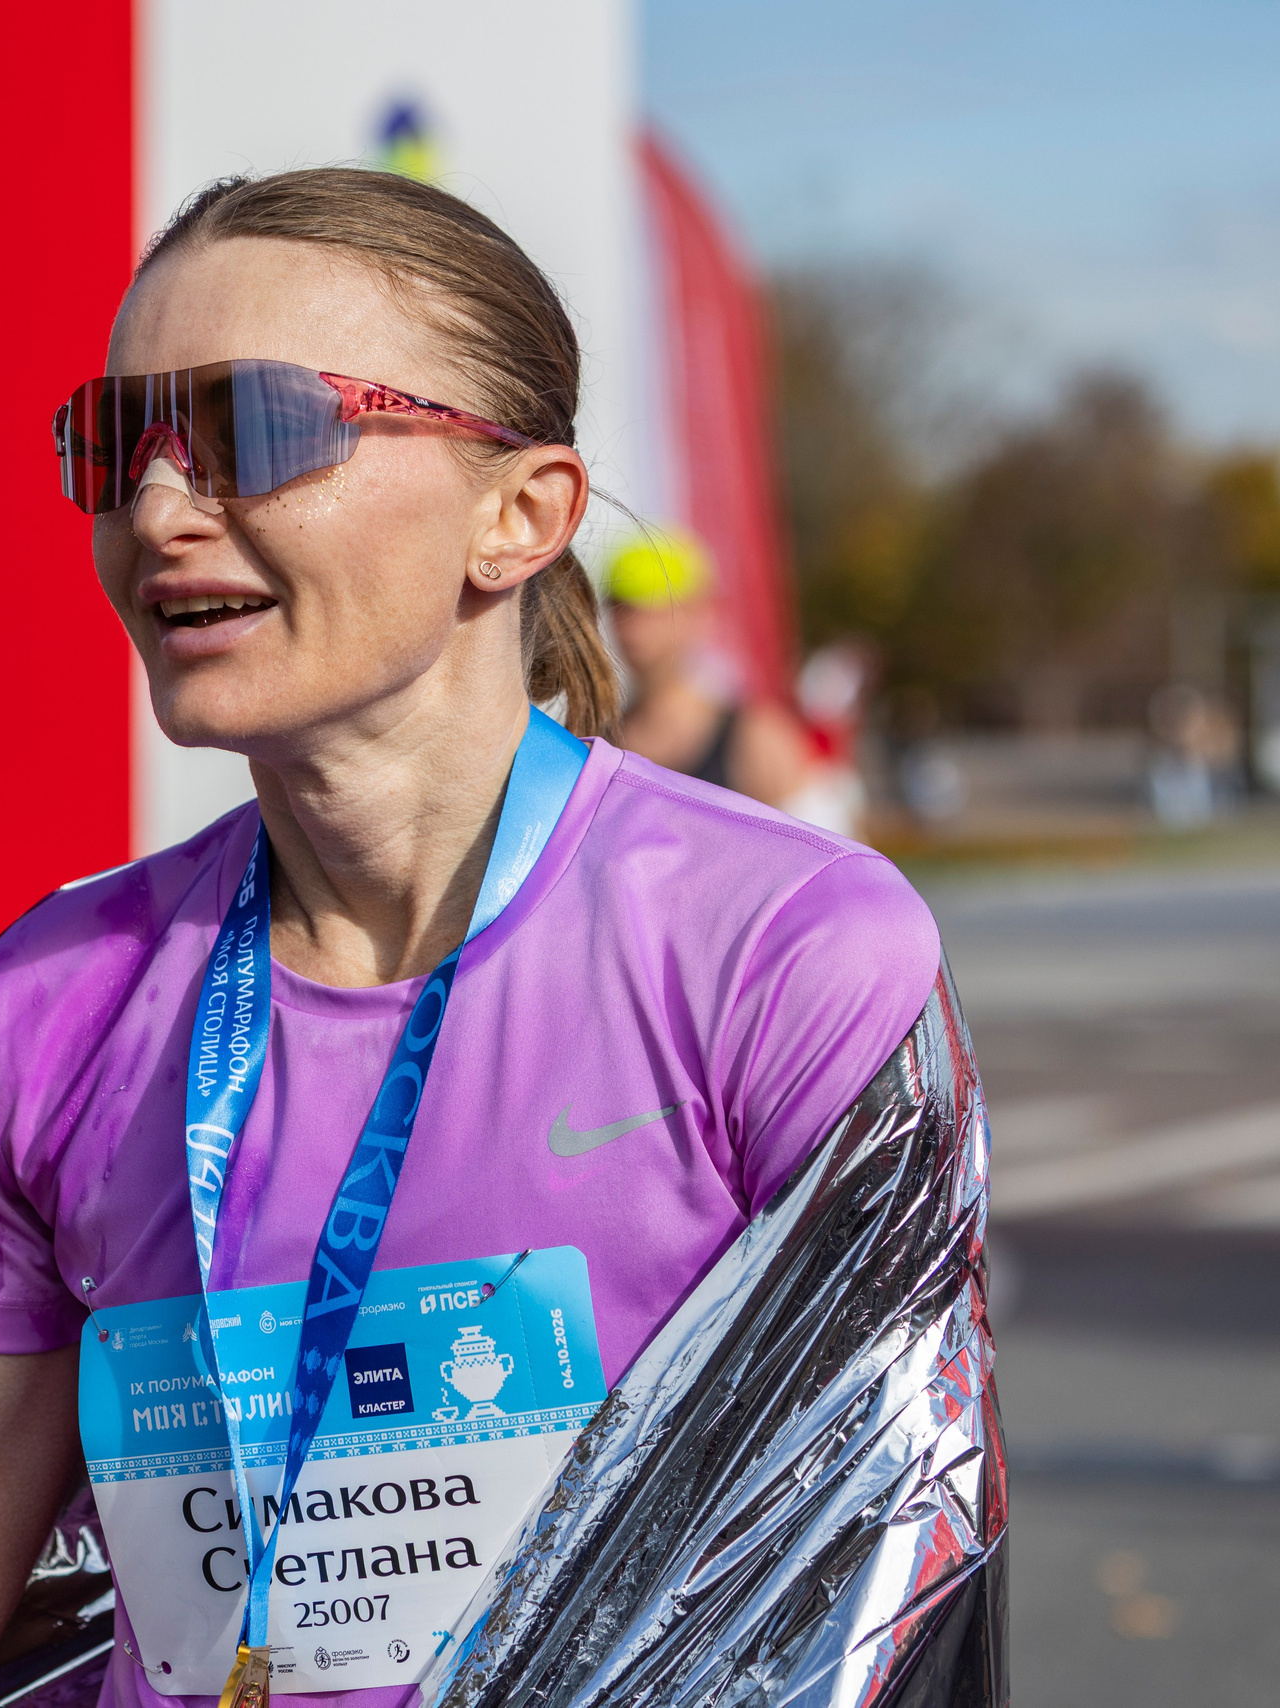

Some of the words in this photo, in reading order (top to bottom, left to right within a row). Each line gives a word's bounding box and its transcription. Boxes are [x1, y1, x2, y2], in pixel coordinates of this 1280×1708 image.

[211, 930, 235, 987] «МОЯ
[227, 915, 258, 1093] ПОЛУМАРАФОН
[195, 991, 227, 1098] СТОЛИЦА»
[306, 945, 462, 1321] ОСКВА
[418, 1282, 454, 1292] ГЕНЕРАЛЬНЫЙ
[454, 1280, 478, 1288] СПОНСОР
[439, 1289, 481, 1312] ПСБ
[209, 1314, 241, 1328] КОВСКИЙ
[550, 1308, 575, 1389] 04.10.2026
[130, 1382, 145, 1395] IX
[353, 1367, 404, 1385] ЭЛИТА
[132, 1402, 187, 1433] МОЯ
[358, 1400, 406, 1414] КЛАСТЕР
[181, 1473, 481, 1533] Симакова
[201, 1536, 482, 1592] Сетлана
[293, 1594, 391, 1628] 25007
